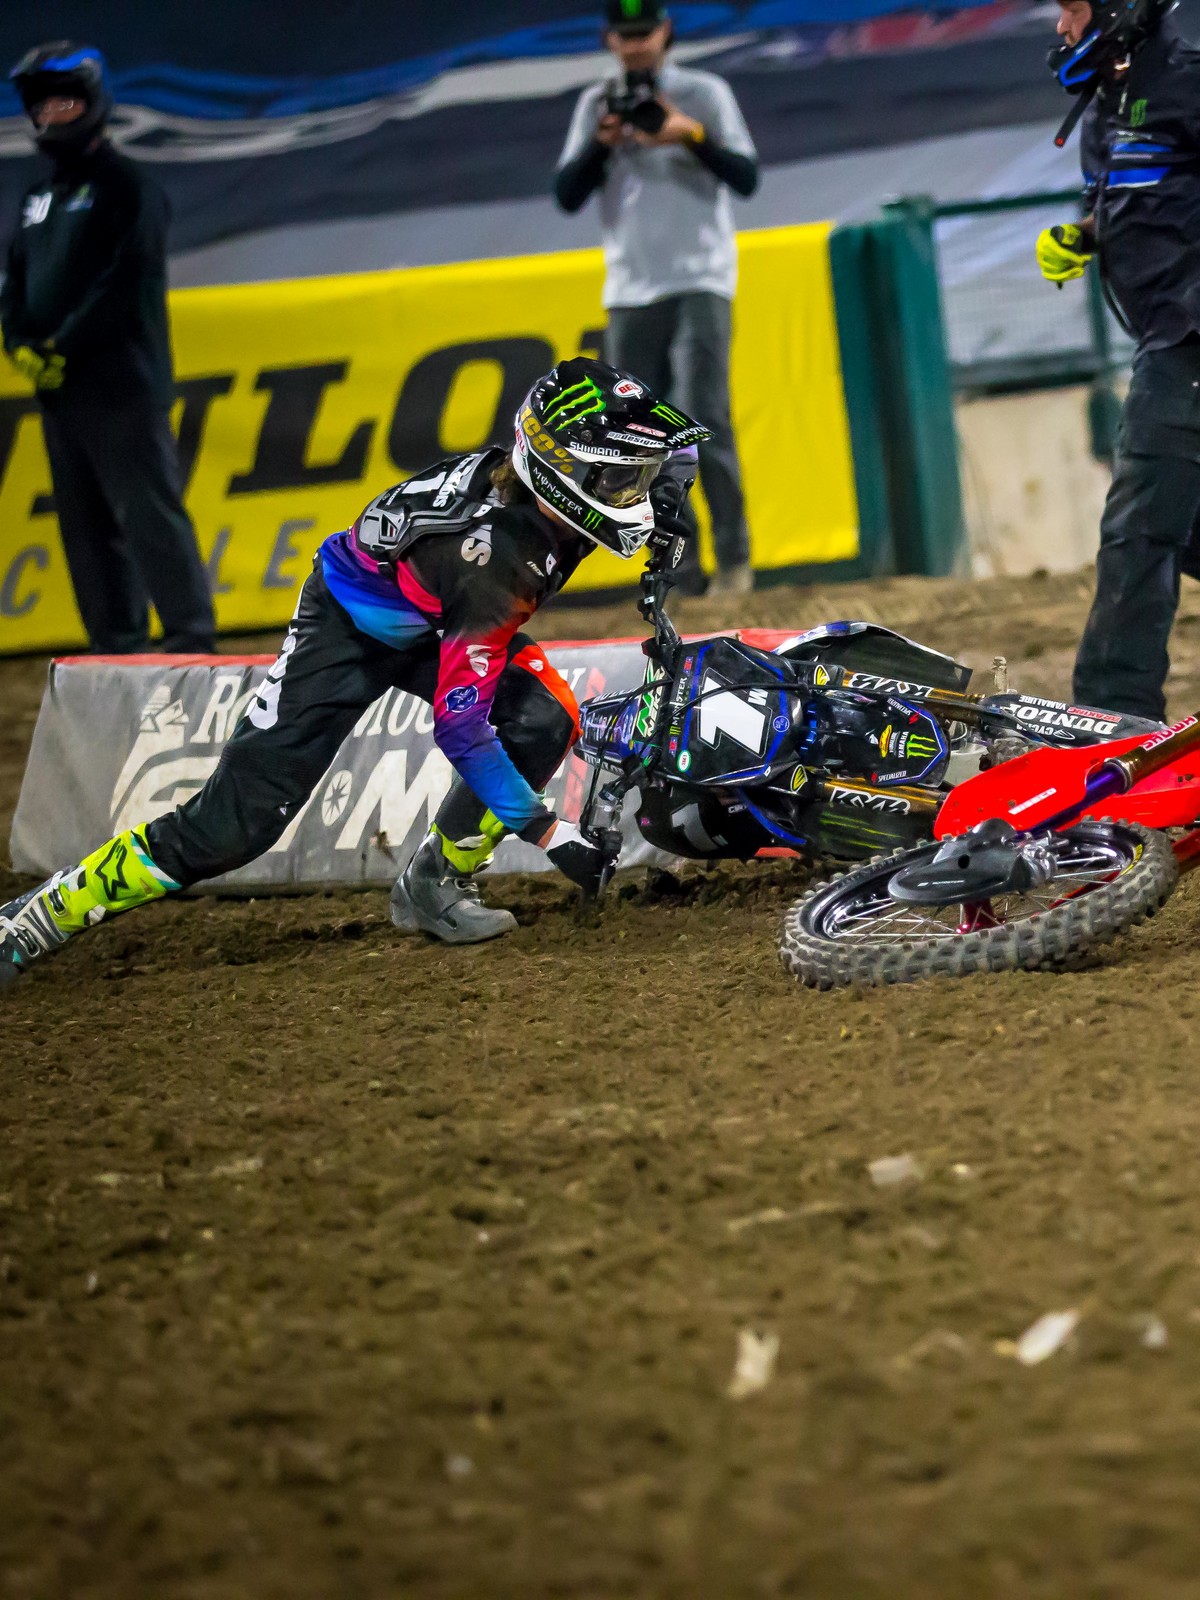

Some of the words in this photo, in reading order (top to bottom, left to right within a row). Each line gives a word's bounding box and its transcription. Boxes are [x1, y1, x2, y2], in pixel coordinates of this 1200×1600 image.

[520, 405, 575, 474] 100%
[569, 441, 621, 458] SHIMANO
[533, 466, 583, 515] MONSTER
[1019, 694, 1067, 711] YAMALUBE
[1067, 706, 1122, 722] BRAKING
[1016, 722, 1055, 737] CYCA
[1142, 715, 1199, 752] SHOWA
[898, 731, 910, 759] YAMAHA
[878, 770, 908, 782] SPECIALIZED
